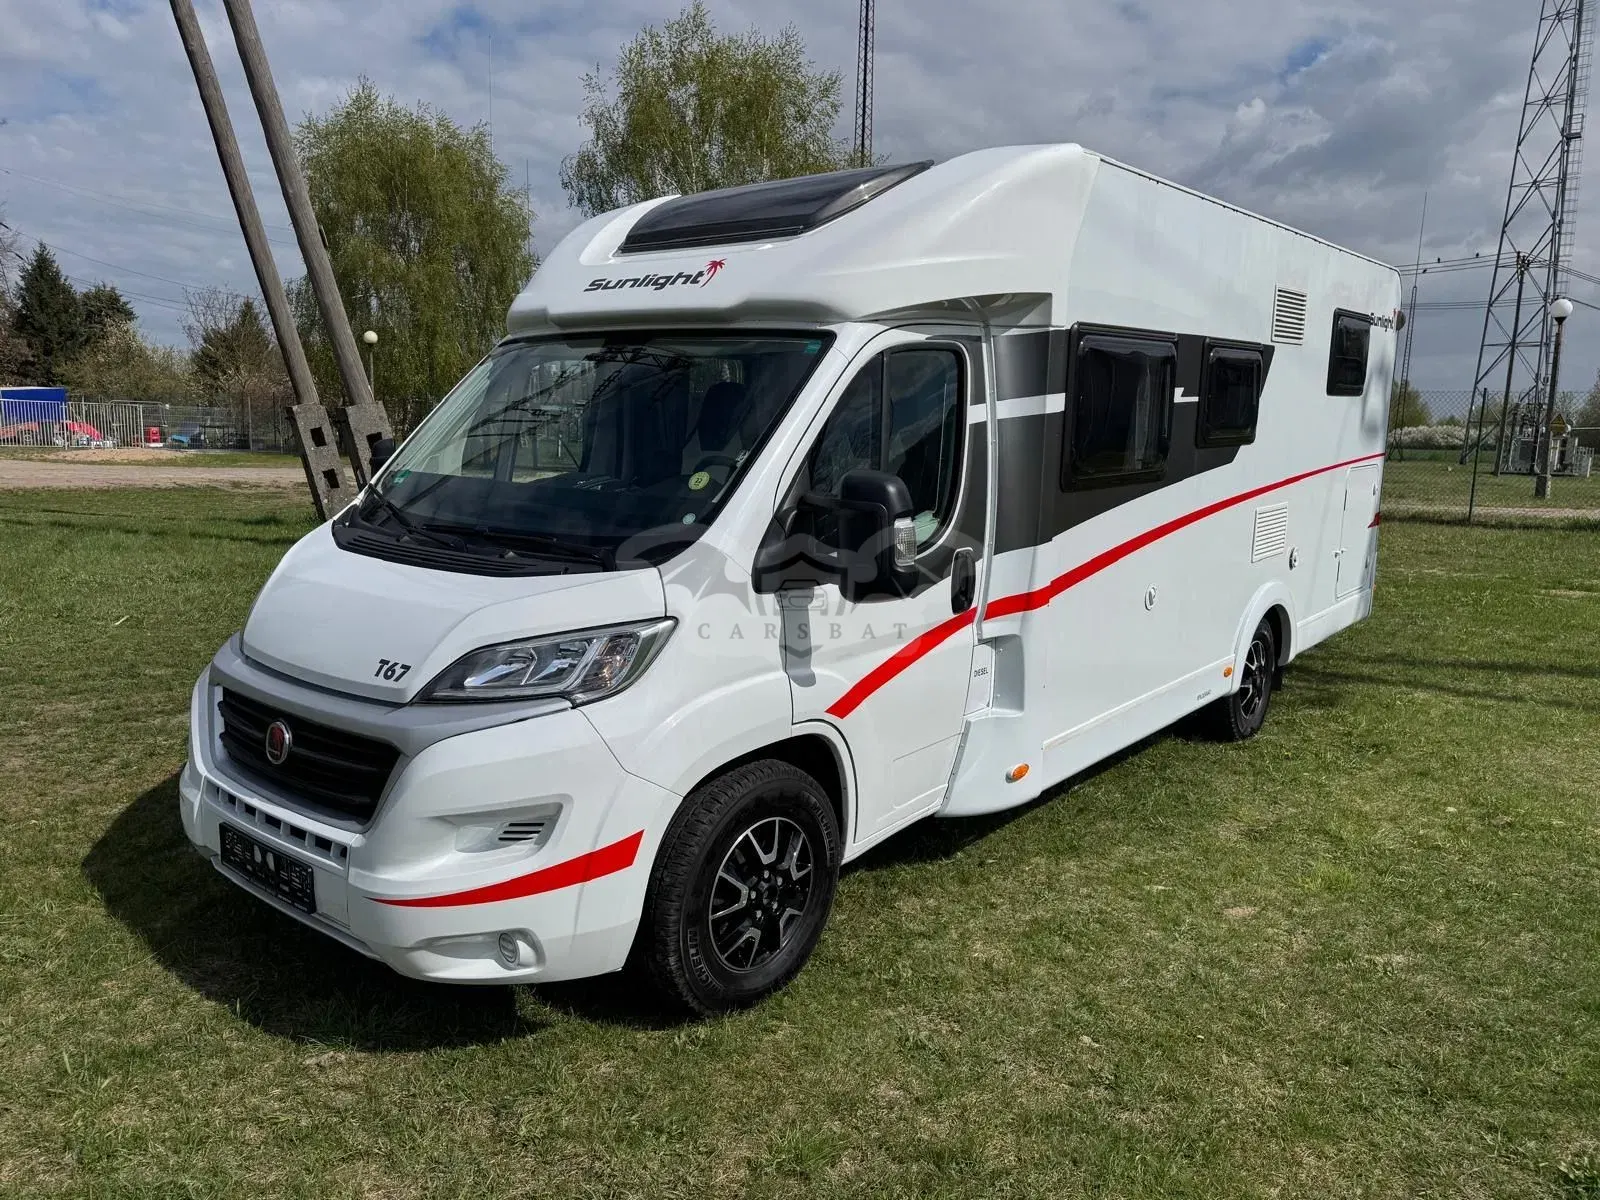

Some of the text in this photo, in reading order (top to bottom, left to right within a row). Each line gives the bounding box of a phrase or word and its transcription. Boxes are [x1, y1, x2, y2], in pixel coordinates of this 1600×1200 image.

[583, 270, 705, 292] Sunlight
[374, 658, 412, 683] T67
[973, 666, 989, 678] DIESEL
